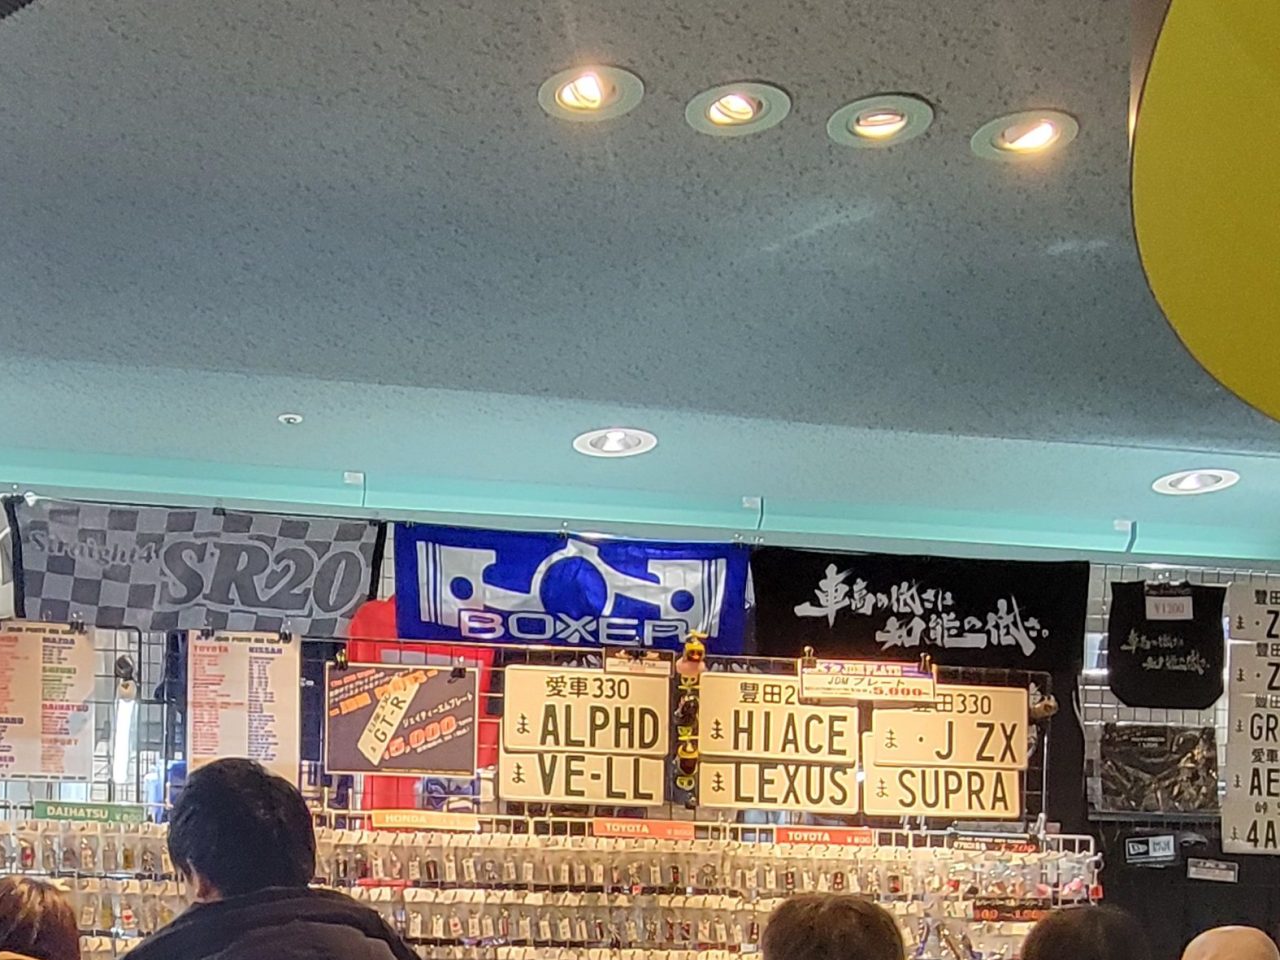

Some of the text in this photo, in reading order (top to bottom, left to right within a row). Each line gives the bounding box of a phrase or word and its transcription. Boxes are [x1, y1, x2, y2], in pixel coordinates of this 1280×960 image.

[161, 539, 363, 613] SR20
[794, 563, 954, 628] 車高の低さは
[459, 610, 691, 646] BOXER
[545, 675, 630, 699] 愛車330
[739, 682, 808, 705] 豊田2
[914, 694, 992, 715] 田330
[373, 696, 407, 744] GT-R
[539, 703, 660, 750] ALPHD
[732, 709, 848, 756] HIACE
[975, 722, 1018, 763] ZX
[538, 753, 654, 801] VE-LL
[734, 761, 848, 805] LEXUS
[898, 769, 1009, 811] SUPRA
[46, 805, 108, 819] DAIHATSU
[385, 813, 427, 824] HONDA
[604, 822, 650, 834] TOYOTA
[787, 830, 831, 842] TOYOTA
